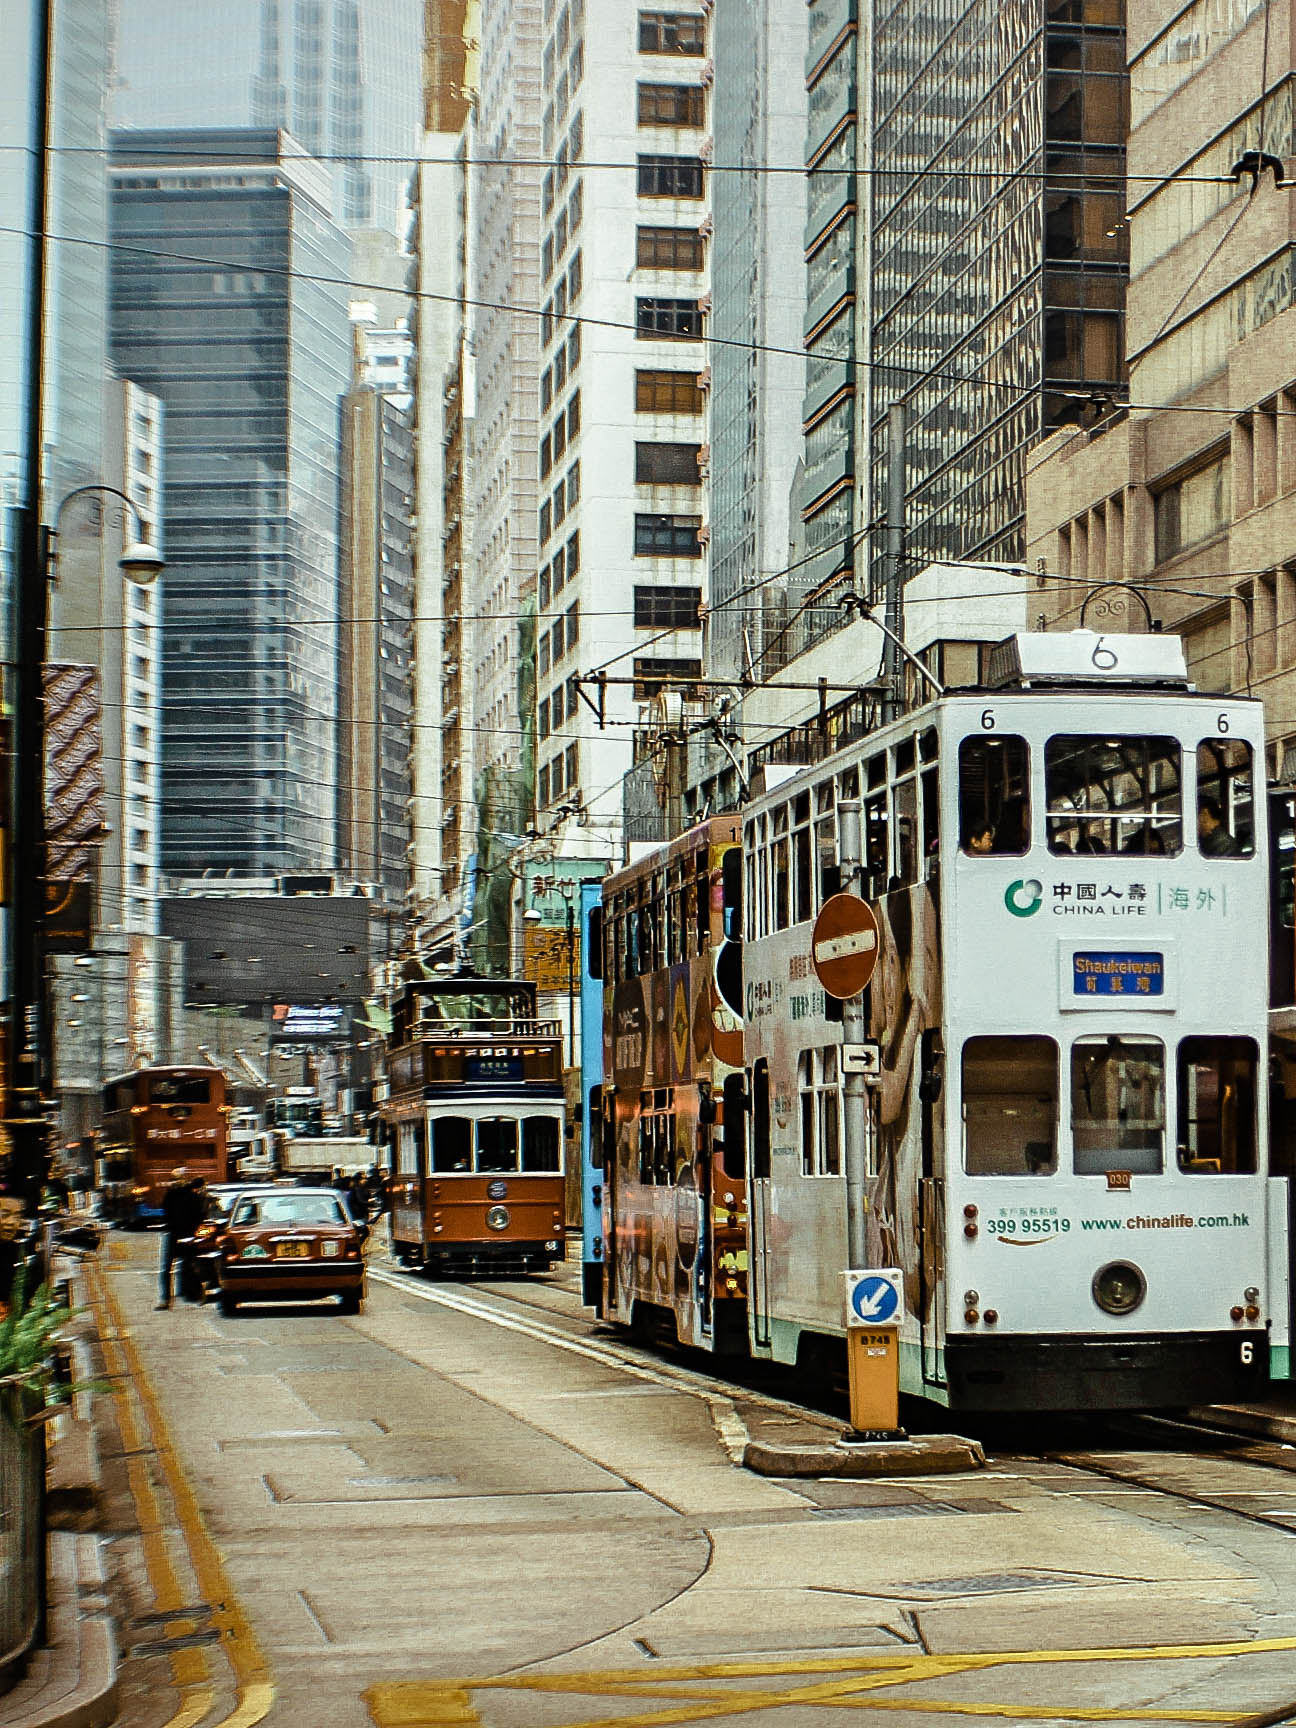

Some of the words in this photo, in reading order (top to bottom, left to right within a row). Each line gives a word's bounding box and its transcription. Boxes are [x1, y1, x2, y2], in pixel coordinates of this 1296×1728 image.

[1091, 636, 1118, 670] 6
[981, 709, 995, 730] 6
[1216, 713, 1230, 733] 6
[1052, 882, 1148, 902] 中國人壽
[1168, 887, 1217, 912] 海外
[1052, 905, 1106, 915] CHINA
[1112, 905, 1148, 915] LIFE
[1075, 957, 1161, 974] Shaukeiwan
[1109, 1174, 1129, 1186] 030
[987, 1219, 1017, 1234] 399
[1021, 1218, 1071, 1233] 95519
[1081, 1212, 1250, 1231] www.chinalife.com.hk
[1239, 1341, 1254, 1365] 6
